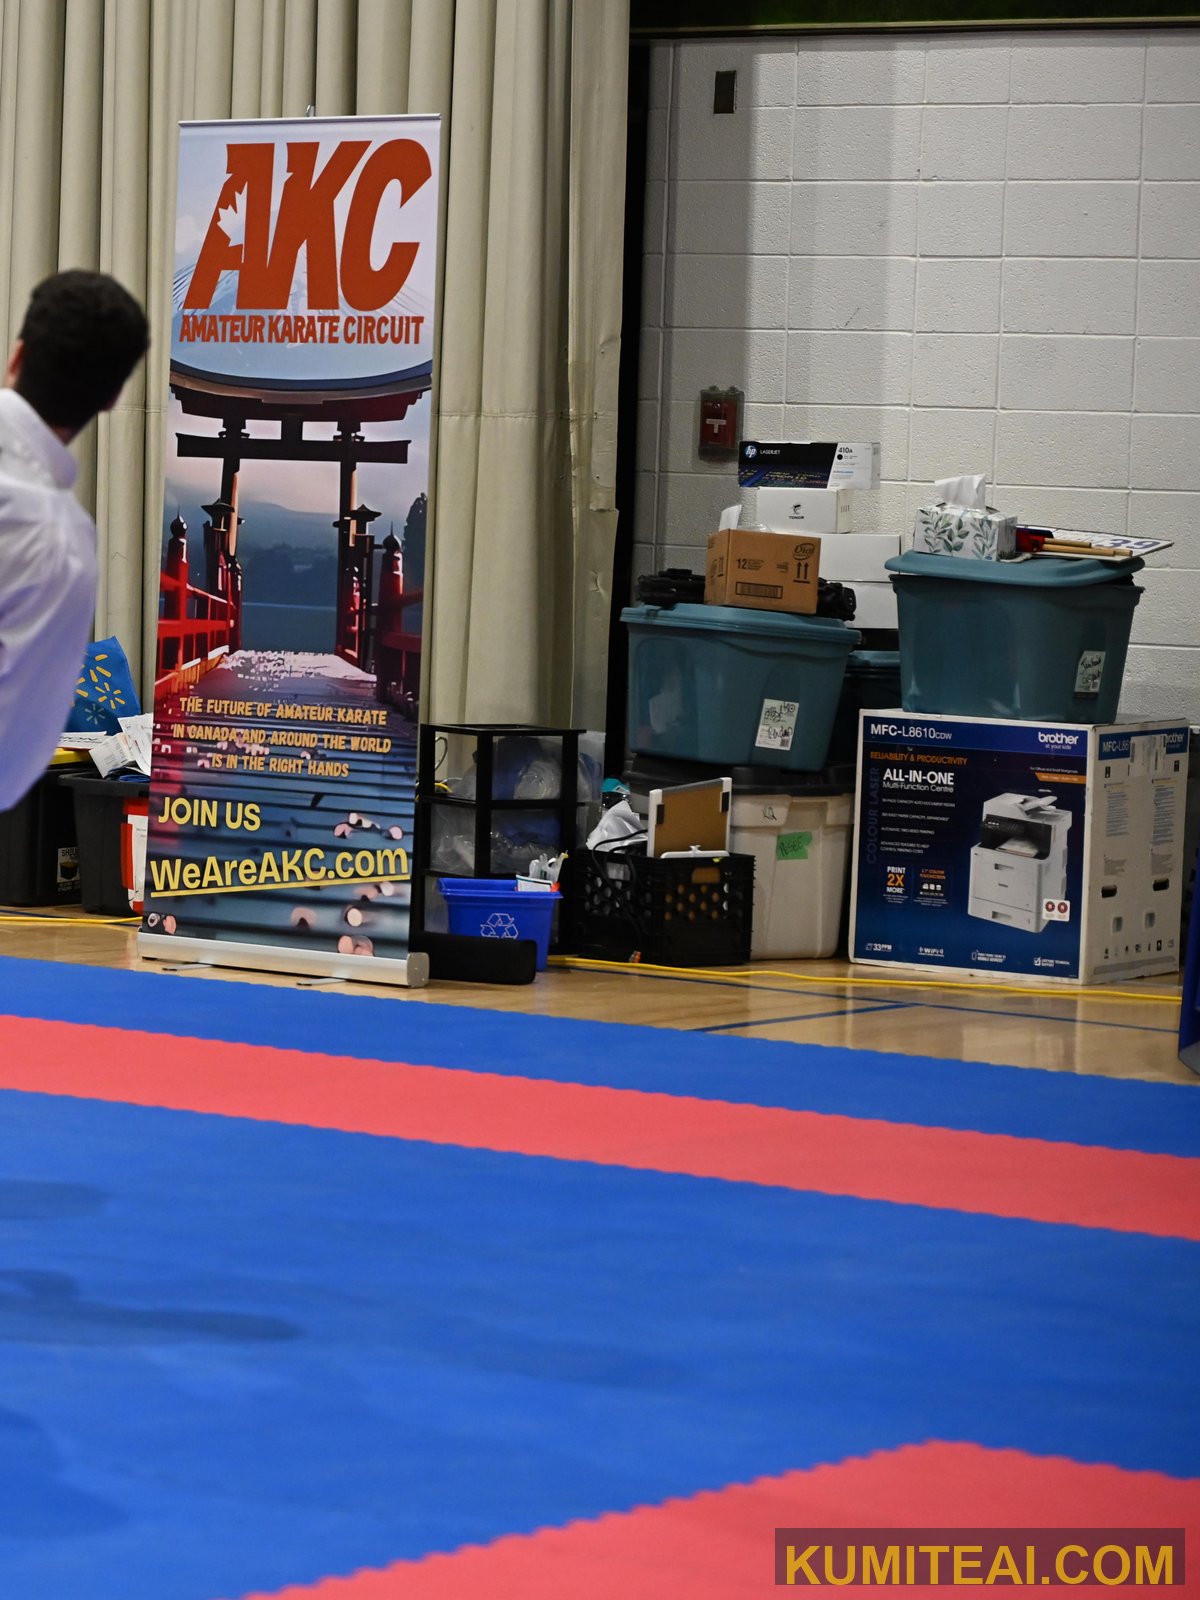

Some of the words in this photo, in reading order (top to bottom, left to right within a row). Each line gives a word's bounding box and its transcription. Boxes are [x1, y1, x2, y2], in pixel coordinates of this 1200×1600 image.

[182, 138, 432, 311] AKC
[179, 315, 265, 343] AMATEUR
[268, 315, 340, 344] KARATE
[343, 316, 424, 344] CIRCUIT
[737, 558, 747, 569] 12
[179, 697, 203, 713] THE
[206, 699, 252, 717] FUTURE
[257, 702, 273, 718] OF
[275, 703, 333, 722] AMATEUR
[337, 707, 388, 726] KARATE
[173, 723, 184, 738] IN
[188, 725, 238, 742] CANADA
[242, 728, 266, 744] AND
[269, 730, 318, 748] AROUND
[322, 734, 346, 750] THE
[350, 736, 391, 754] WORLD
[870, 723, 952, 740] MFC-L8610CDW
[1038, 731, 1079, 745] brother
[211, 753, 222, 768] IS
[226, 754, 238, 769] IN
[242, 755, 265, 771] THE
[269, 757, 304, 775] RIGHT
[307, 760, 349, 778] HANDS
[870, 751, 908, 761] RELIABILITY
[917, 754, 968, 765] PRODUCTIVITY
[882, 768, 955, 786] ALL-IN-ONE
[882, 781, 930, 791] Multi-Function
[930, 784, 954, 793] Centre
[158, 796, 218, 828] JOIN
[225, 801, 261, 832] US
[150, 847, 409, 891] WeAreAKC.com
[886, 866, 906, 874] PRINT
[887, 874, 904, 886] 2X
